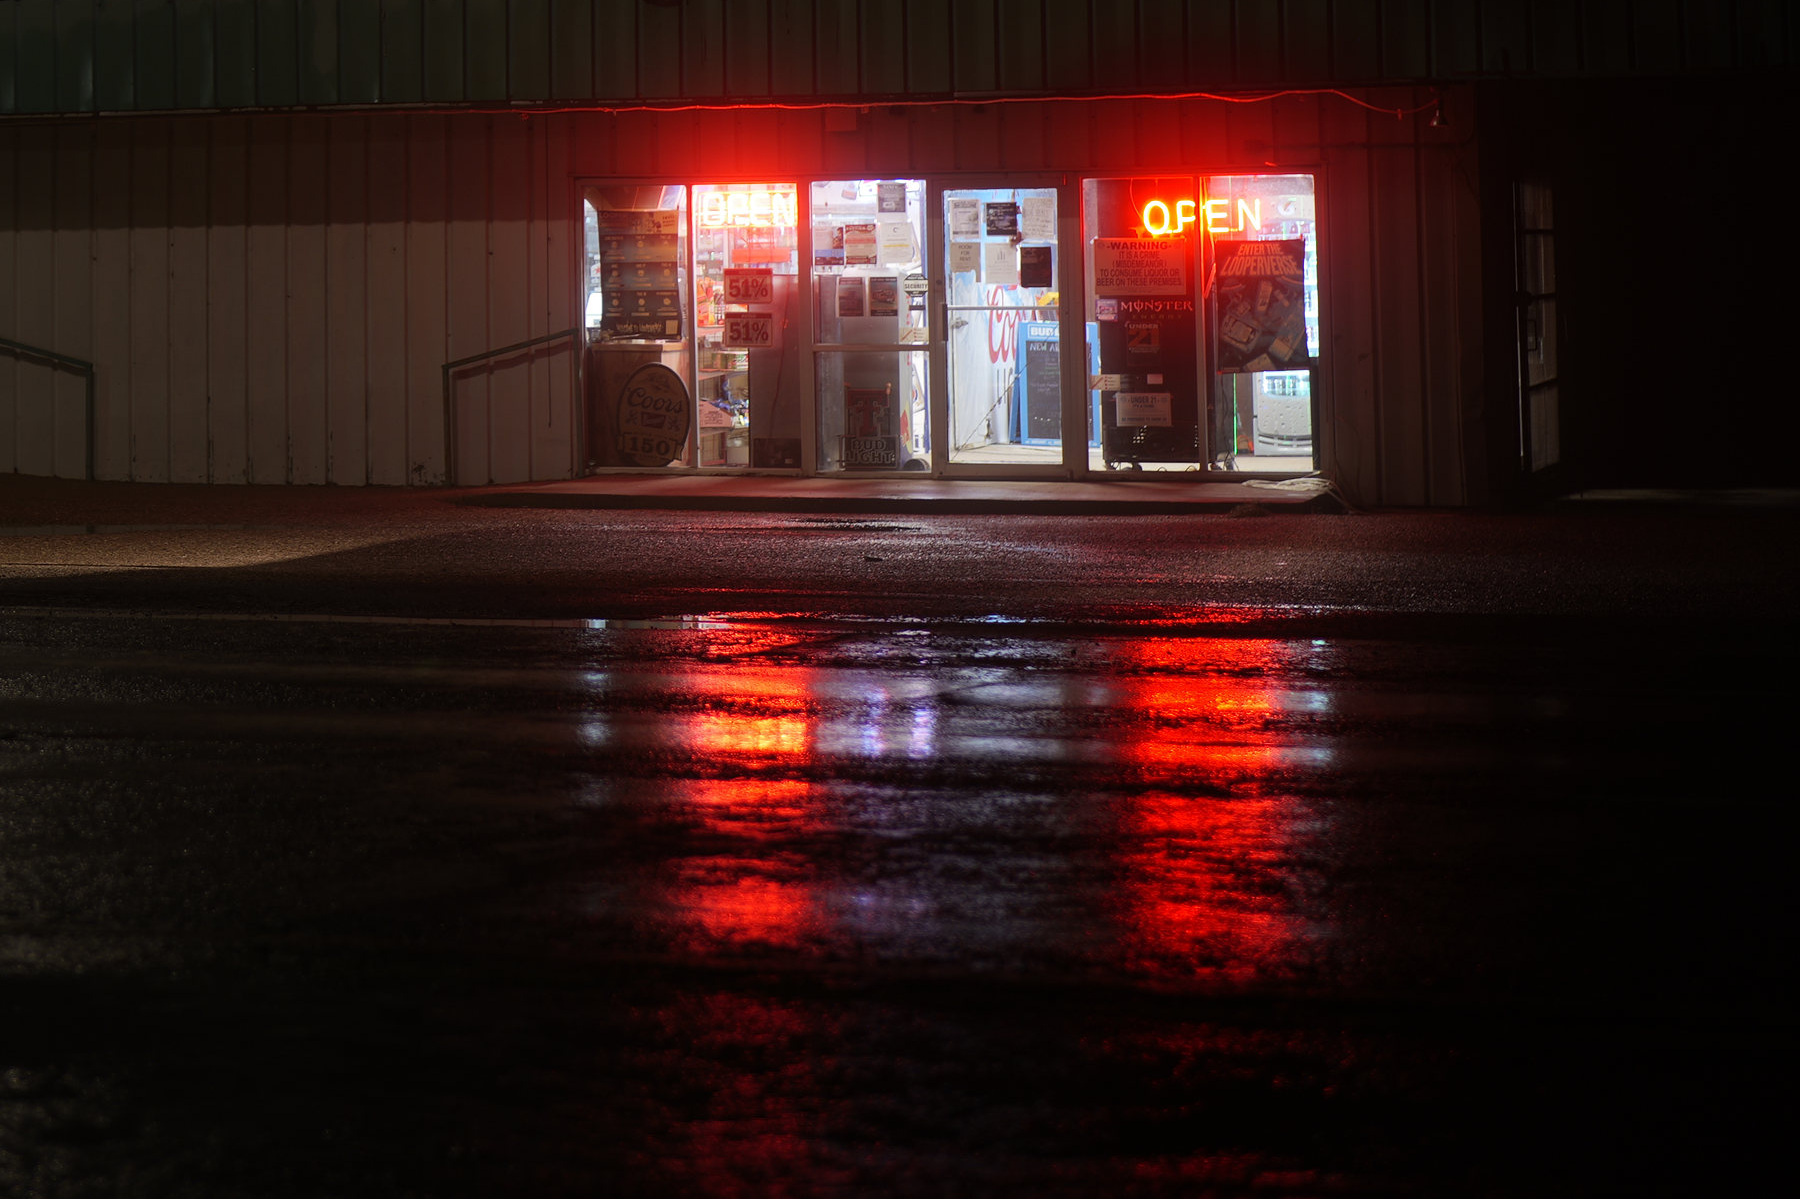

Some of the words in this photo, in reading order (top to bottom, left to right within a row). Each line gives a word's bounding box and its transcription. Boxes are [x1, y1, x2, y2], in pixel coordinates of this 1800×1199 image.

[702, 192, 795, 226] OPEN
[1143, 198, 1262, 235] OPEN
[1140, 251, 1161, 259] CRIME
[1237, 243, 1265, 256] ENTER
[1265, 243, 1282, 255] THE
[1143, 268, 1168, 277] LIQUOR
[1220, 255, 1301, 276] LOOPERVERSE
[729, 279, 769, 298] 51%
[1096, 278, 1115, 286] BEER
[1120, 299, 1193, 312] MONSTER
[729, 321, 769, 342] 51%
[1128, 329, 1160, 348] 21
[1030, 343, 1047, 351] NEW
[627, 386, 684, 414] Coors
[628, 436, 671, 456] 150
[852, 439, 887, 451] BUD
[845, 450, 893, 464] LIGHT
